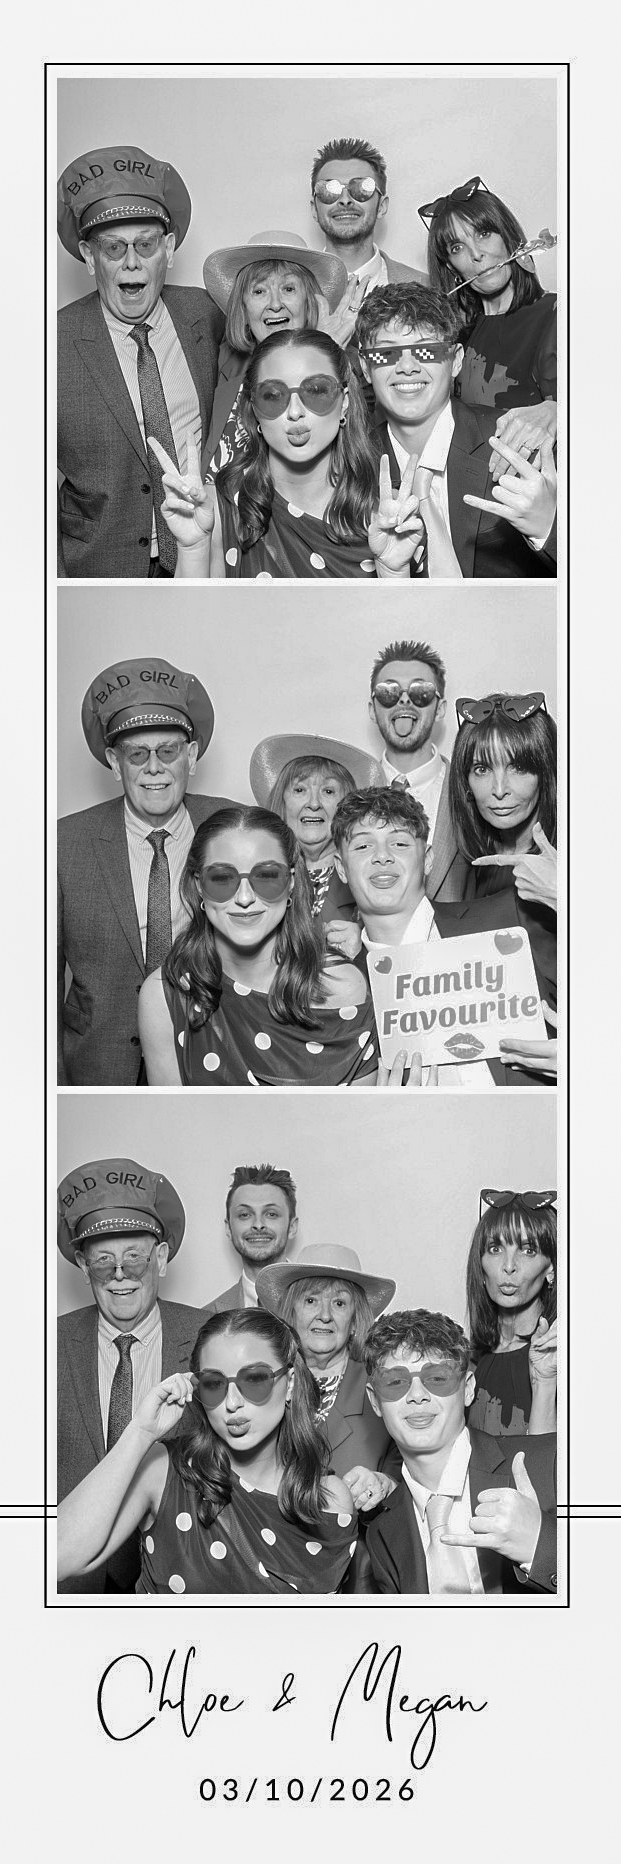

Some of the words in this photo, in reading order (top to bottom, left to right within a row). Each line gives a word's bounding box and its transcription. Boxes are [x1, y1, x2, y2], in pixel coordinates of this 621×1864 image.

[67, 164, 104, 195] BAD
[113, 159, 155, 179] GIRL
[95, 674, 131, 704] BAD
[139, 670, 179, 689] GIRL
[396, 961, 504, 1000] Family
[383, 992, 538, 1036] Favourite
[62, 1177, 97, 1208] BAD
[105, 1171, 146, 1191] GIRL
